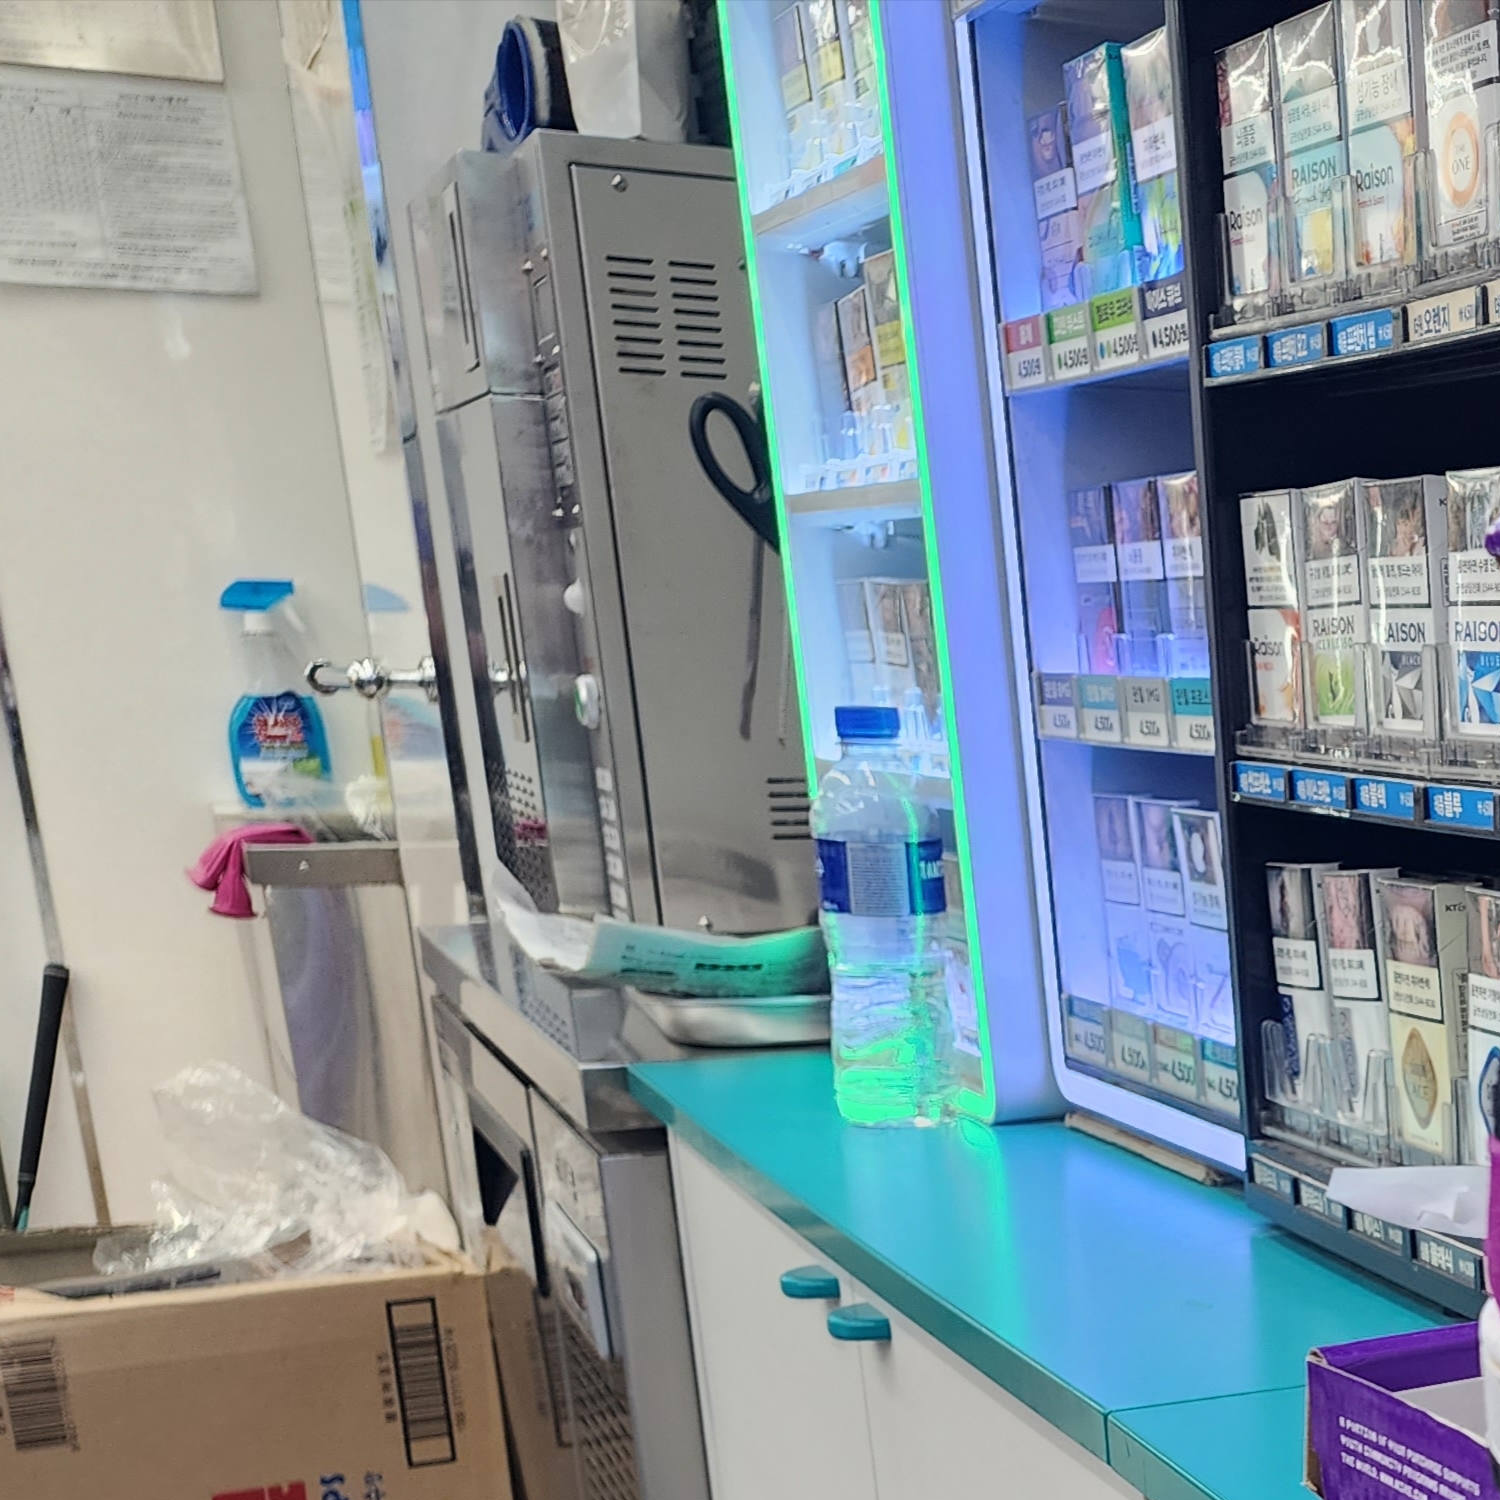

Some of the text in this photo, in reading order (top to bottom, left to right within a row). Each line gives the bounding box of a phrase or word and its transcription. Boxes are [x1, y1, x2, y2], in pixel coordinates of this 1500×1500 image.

[1291, 155, 1337, 190] RAISON
[1451, 156, 1471, 174] ONE
[1355, 163, 1394, 193] Raison
[1230, 204, 1263, 231] Raison
[1423, 302, 1450, 333] 오렌지
[1312, 614, 1355, 638] RAISON
[1376, 621, 1426, 644] AISON
[1401, 654, 1422, 667] BLACK
[1480, 654, 1500, 667] BLUE
